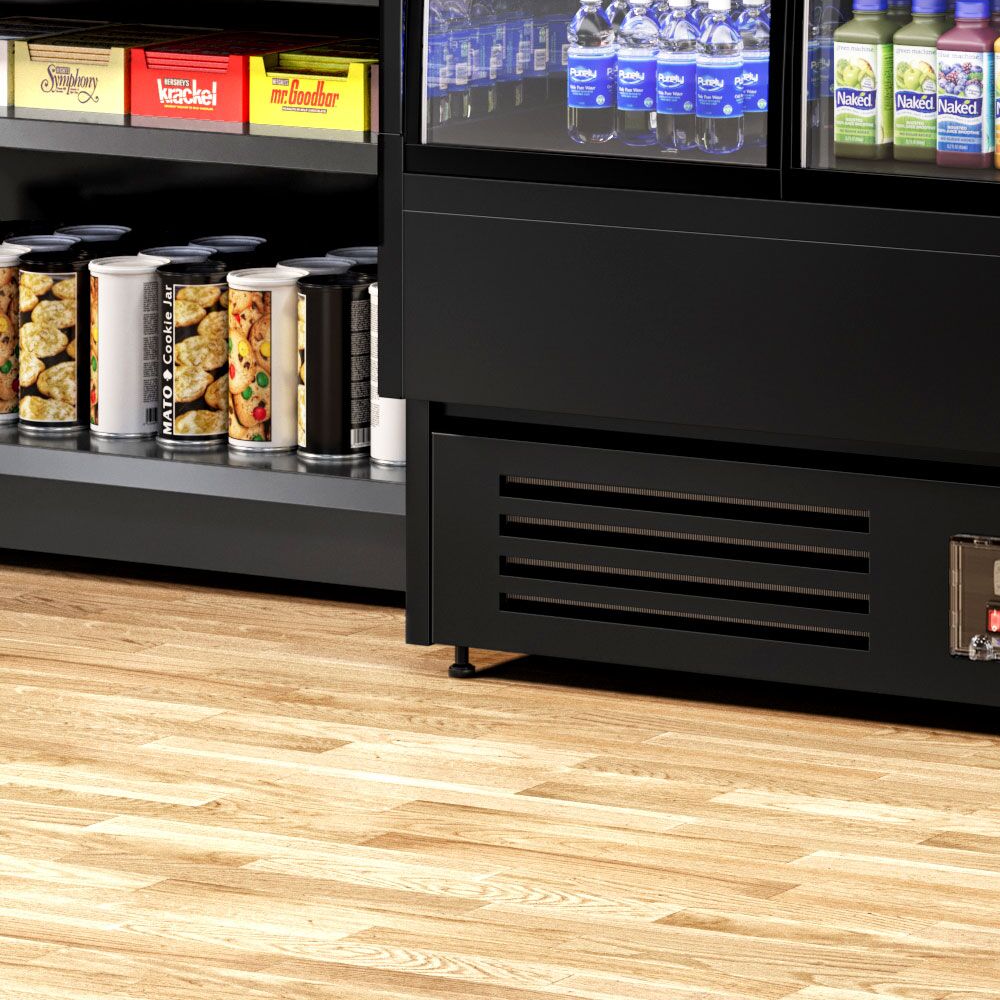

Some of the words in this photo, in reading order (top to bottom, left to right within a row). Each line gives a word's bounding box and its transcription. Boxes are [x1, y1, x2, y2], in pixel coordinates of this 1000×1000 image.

[40, 63, 101, 105] Symphony
[156, 78, 218, 107] krackel
[270, 88, 288, 105] mr.
[287, 80, 341, 109] Goodbar
[837, 91, 872, 107] Naked
[897, 94, 935, 110] Naked
[938, 98, 978, 115] Naked
[162, 283, 174, 309] Jar
[162, 311, 174, 366] Cookie
[162, 384, 174, 437] MATO
